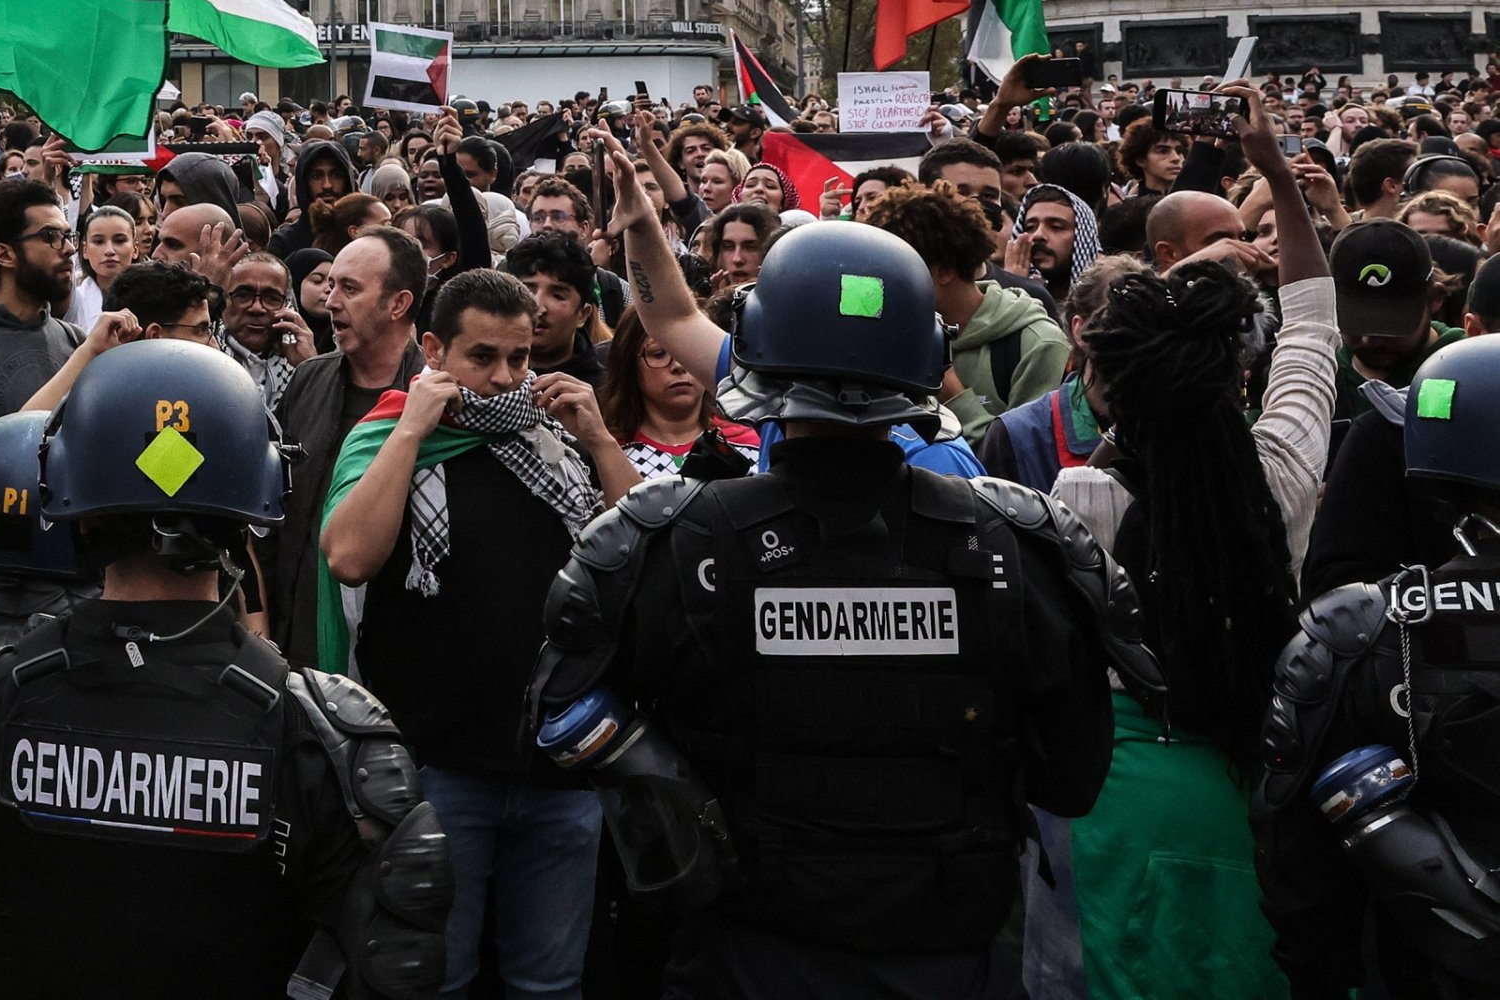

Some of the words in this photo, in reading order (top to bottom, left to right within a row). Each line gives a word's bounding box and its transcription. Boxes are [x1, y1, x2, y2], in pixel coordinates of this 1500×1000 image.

[672, 21, 694, 33] WALL
[695, 22, 722, 34] STREET
[847, 107, 871, 119] STOP
[876, 106, 925, 119] APARTHEID
[847, 119, 868, 129] STOP
[871, 120, 921, 129] COLONISATIO
[155, 400, 190, 432] P3
[3, 487, 28, 515] P1
[1401, 581, 1500, 612] GEN
[760, 600, 955, 641] GENDARMERIE
[11, 738, 262, 826] GENDARMERIE
